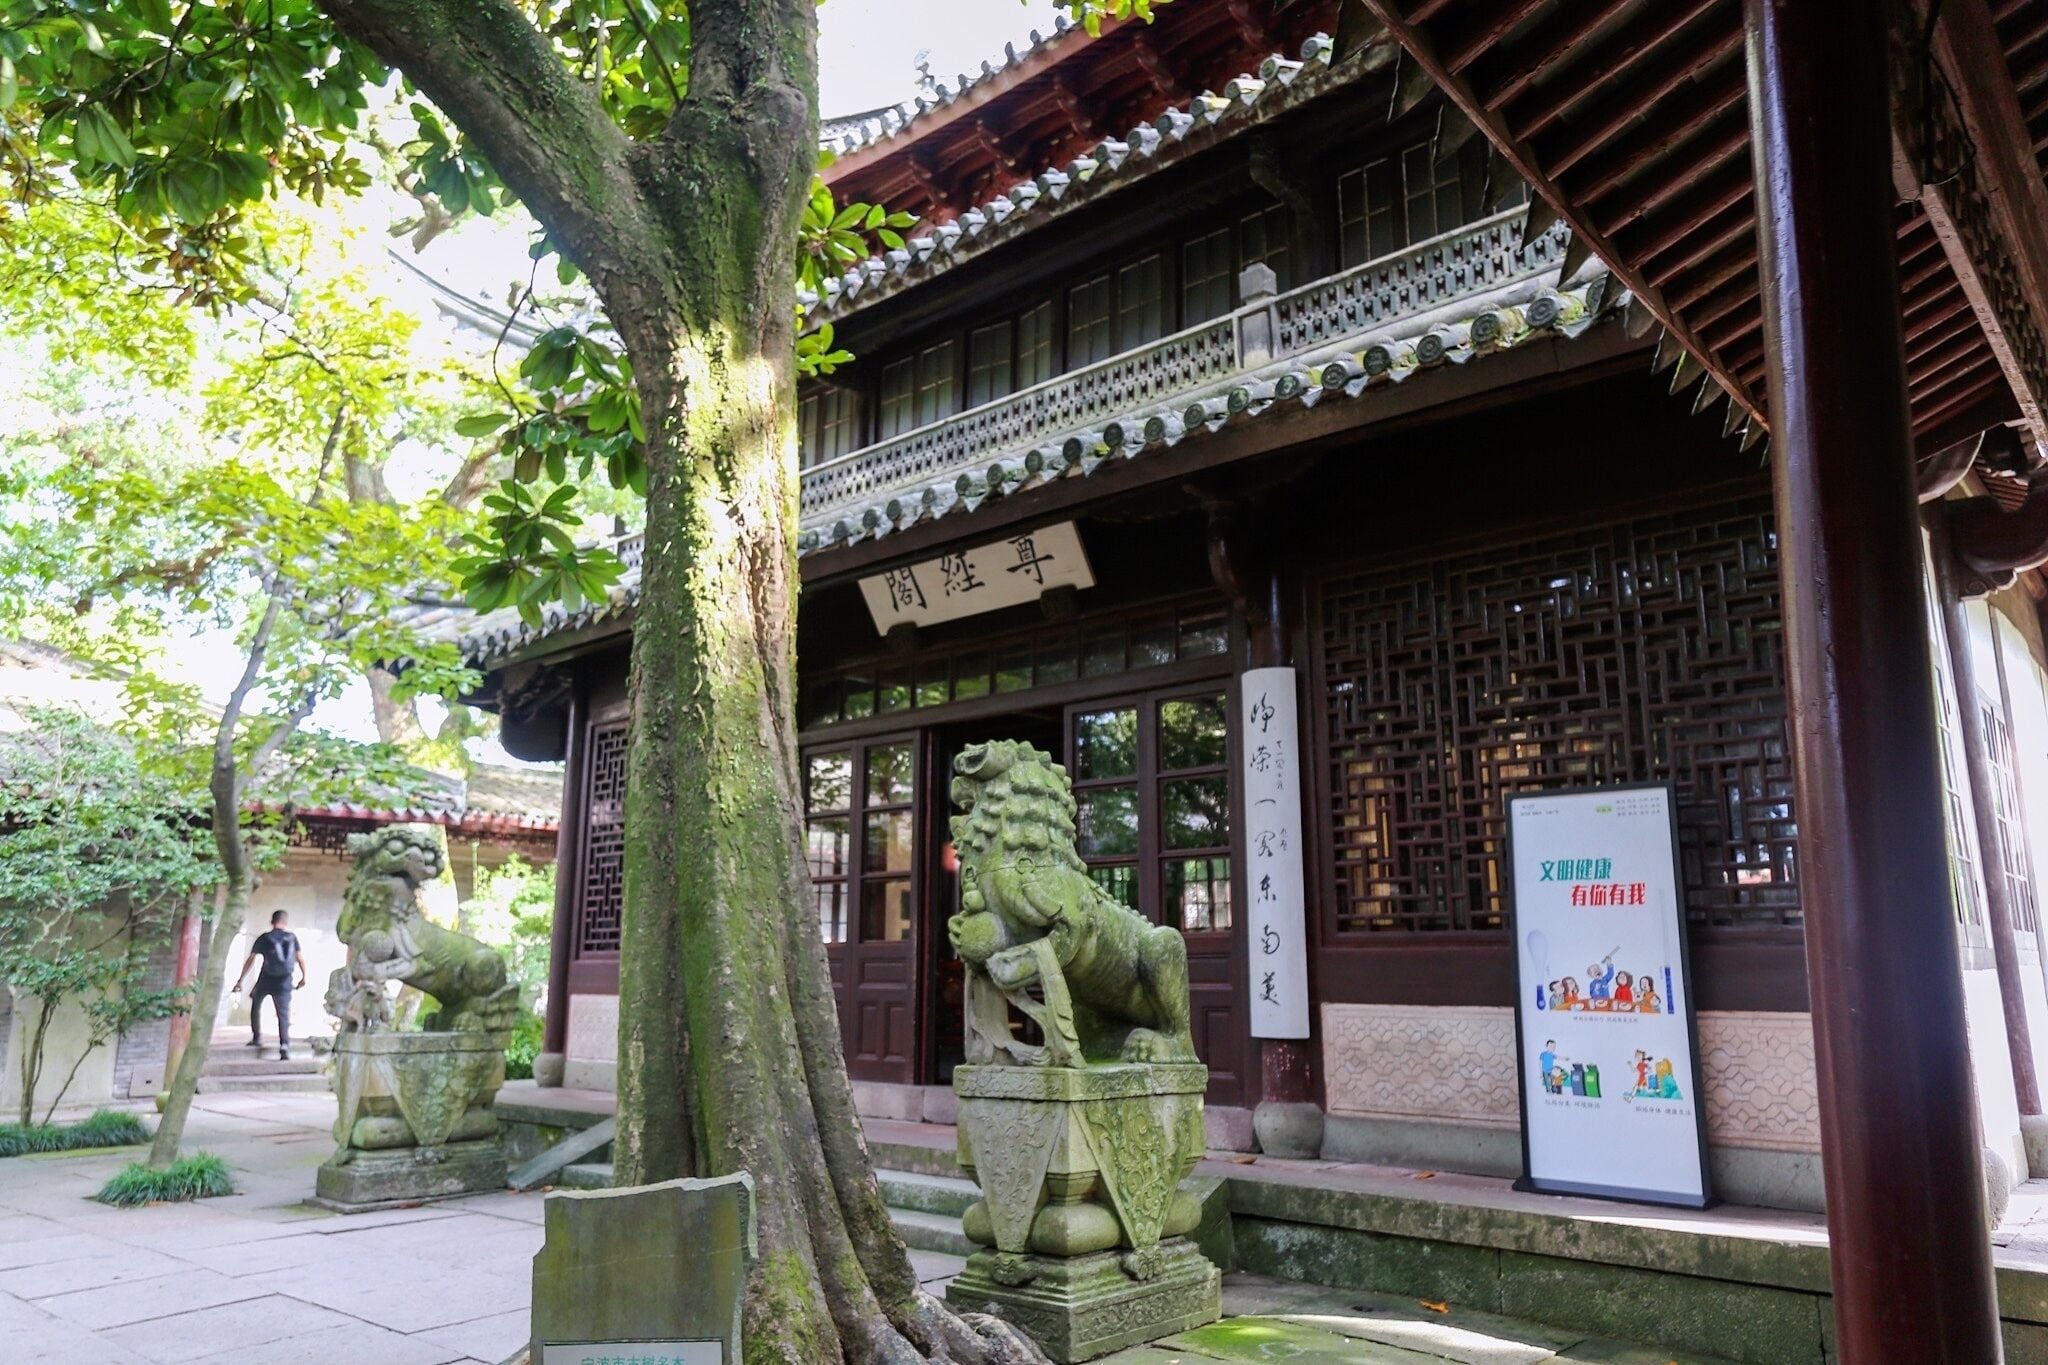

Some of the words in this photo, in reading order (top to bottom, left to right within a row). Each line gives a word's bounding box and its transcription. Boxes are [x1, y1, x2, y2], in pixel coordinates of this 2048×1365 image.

[1540, 858, 1612, 881] 文明健康
[1571, 883, 1645, 906] 有你有我
